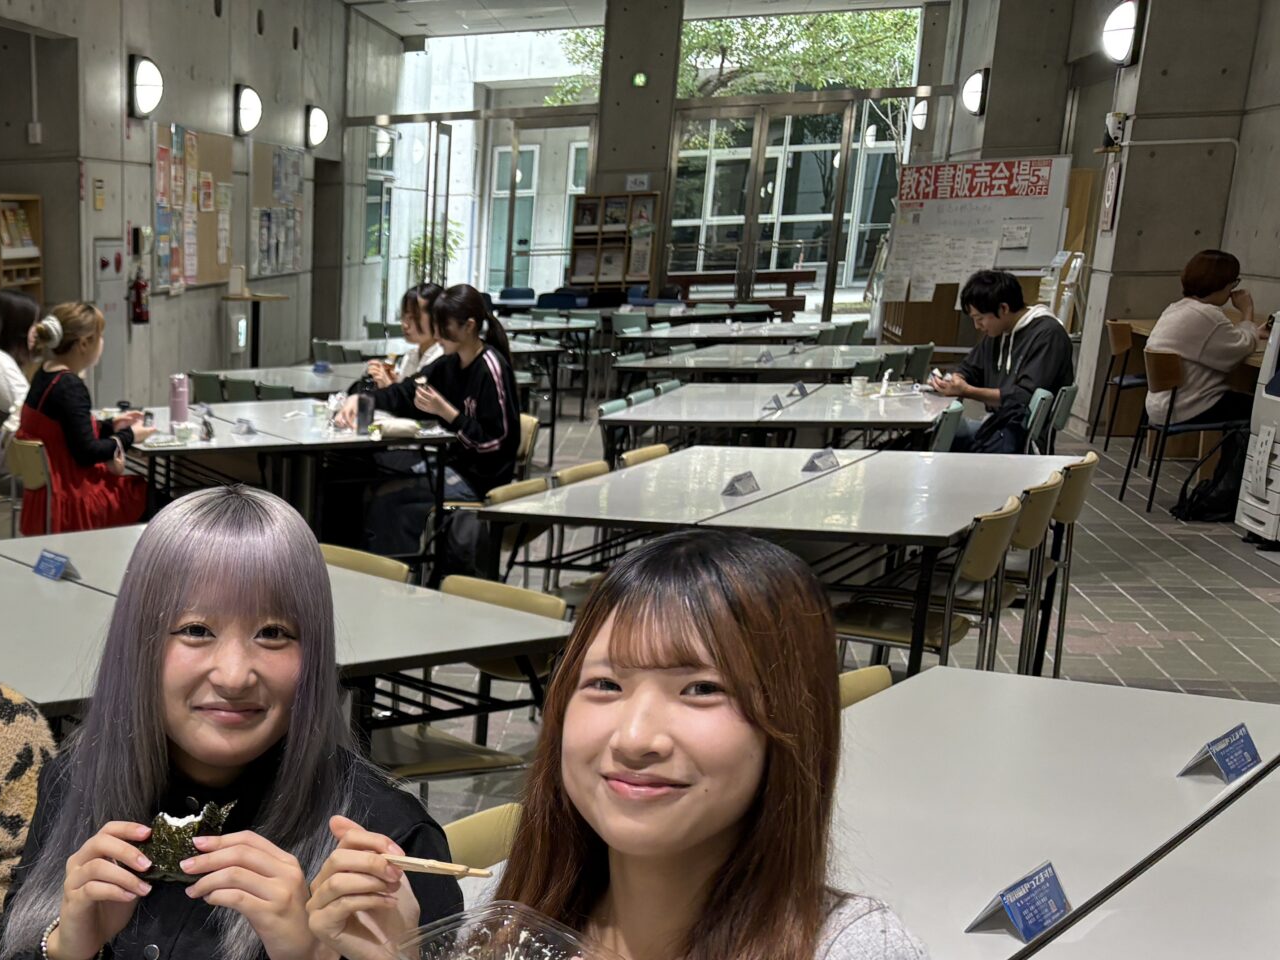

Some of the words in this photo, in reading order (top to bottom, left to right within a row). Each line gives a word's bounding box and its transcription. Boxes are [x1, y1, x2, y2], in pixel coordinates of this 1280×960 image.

[901, 159, 1030, 199] 教科書販売会場
[1028, 185, 1048, 195] OFF
